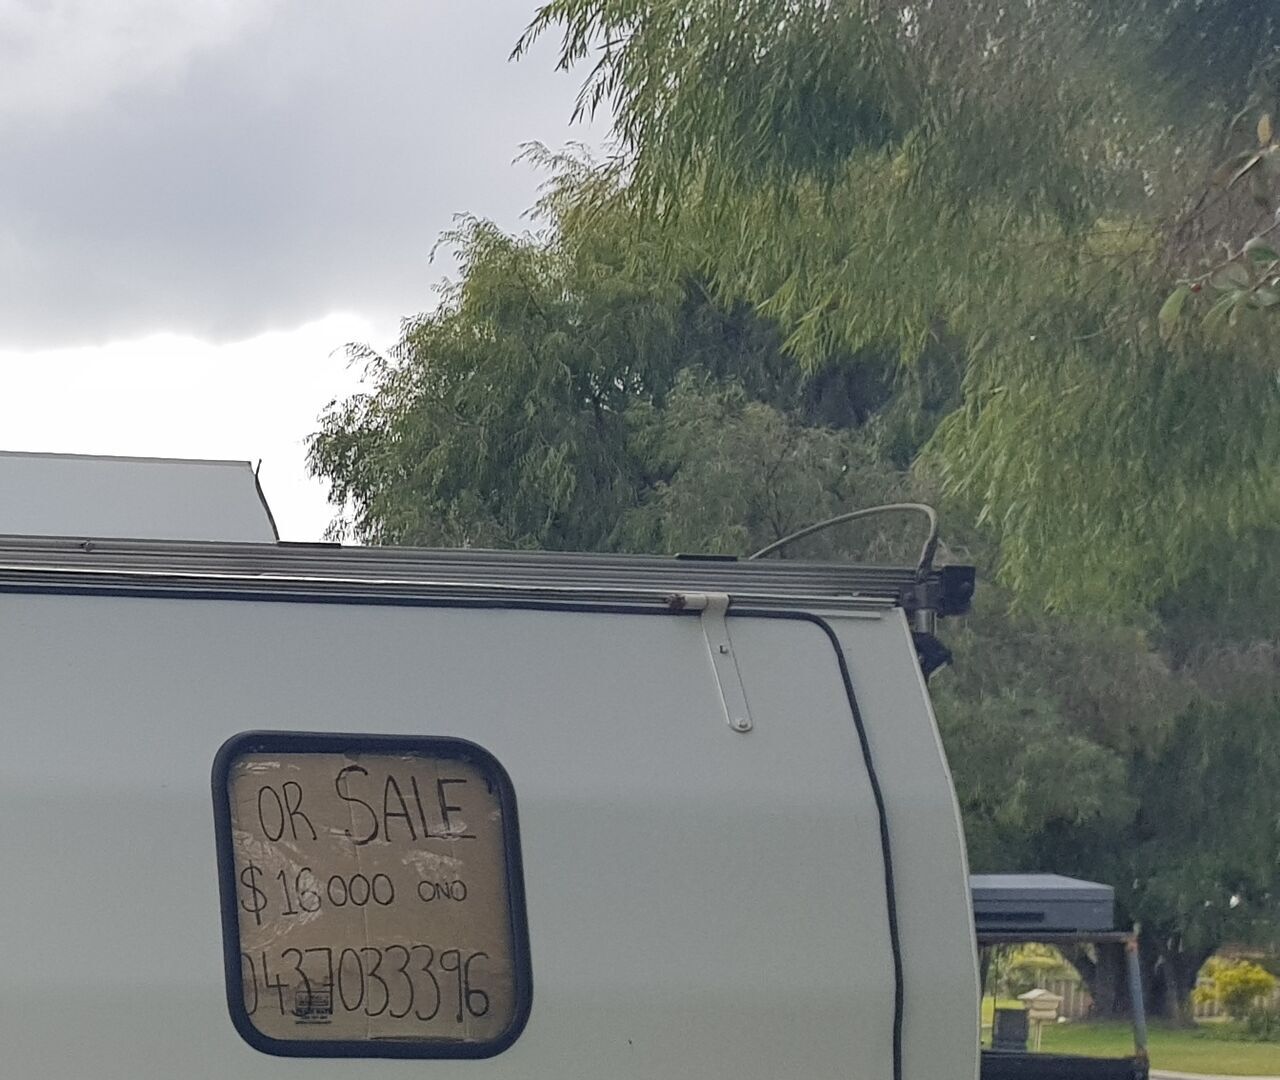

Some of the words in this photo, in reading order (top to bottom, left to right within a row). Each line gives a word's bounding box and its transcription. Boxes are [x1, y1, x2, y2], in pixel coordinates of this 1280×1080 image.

[258, 783, 317, 841] OR
[335, 765, 476, 845] SALE
[417, 880, 467, 902] ONO
